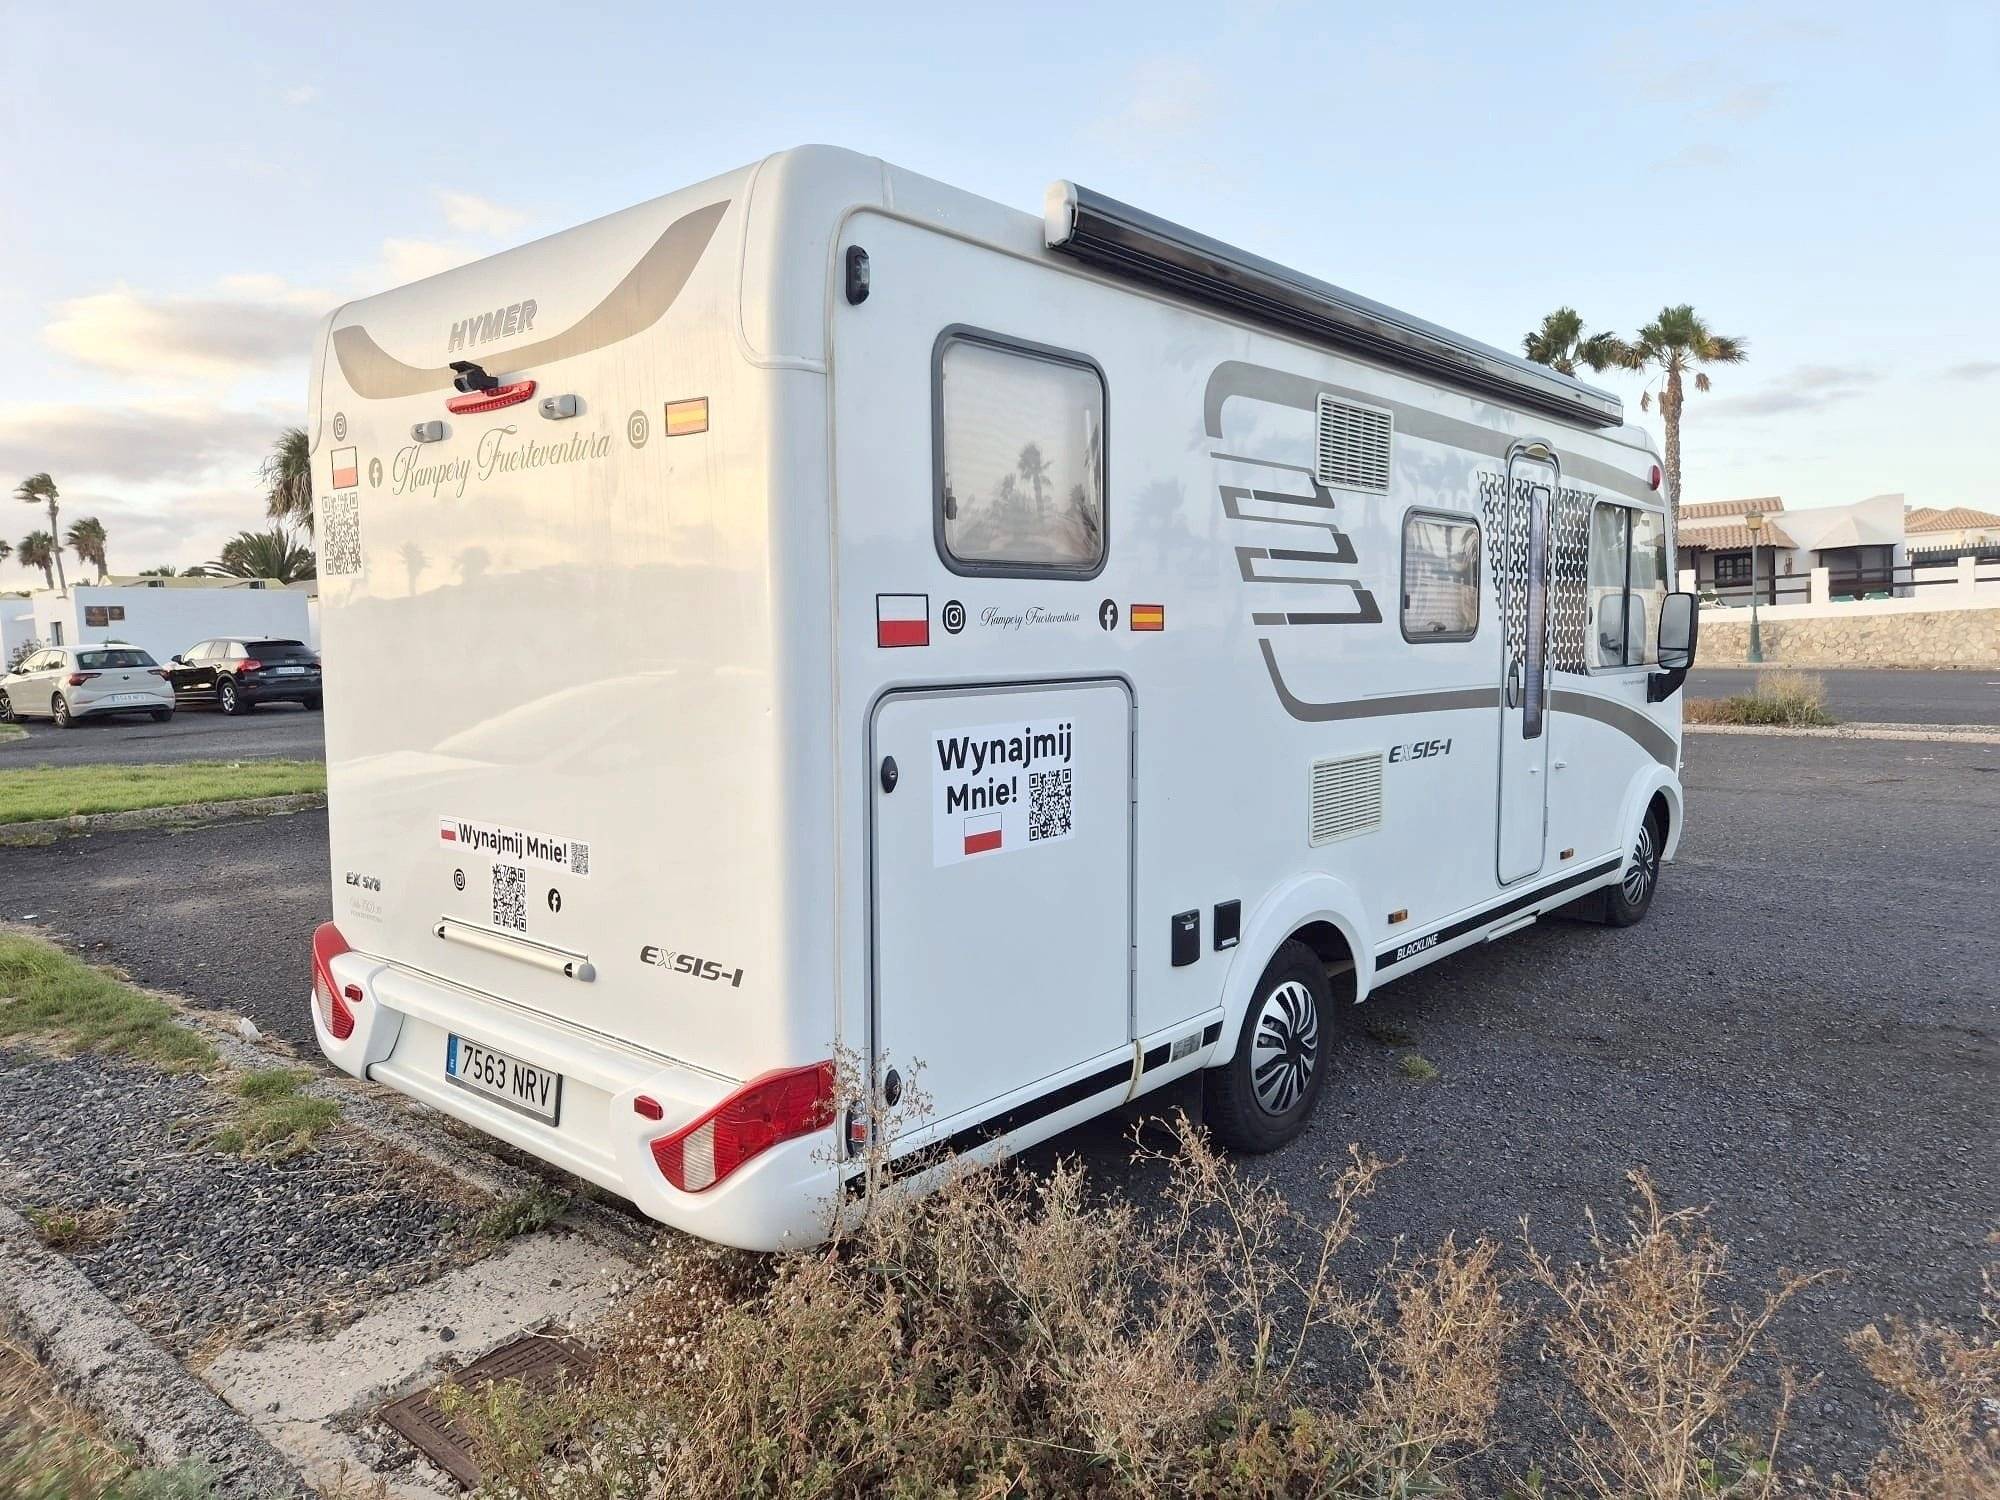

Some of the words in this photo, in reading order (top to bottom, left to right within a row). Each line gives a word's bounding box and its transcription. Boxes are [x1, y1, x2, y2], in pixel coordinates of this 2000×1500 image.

[448, 299, 538, 353] HYMER
[392, 443, 471, 498] Kampery
[477, 424, 611, 481] Fuerteventura
[980, 606, 1022, 631] Kampery
[936, 722, 1072, 776] Wynajmij
[946, 775, 1018, 815] Mnie!
[458, 823, 523, 859] Wynajmij
[526, 835, 568, 864] Mnie!
[640, 945, 744, 988] EXSIS-I
[1396, 933, 1439, 961] BLACKLINE
[462, 1044, 507, 1090] 7563
[512, 1063, 552, 1107] NRV
